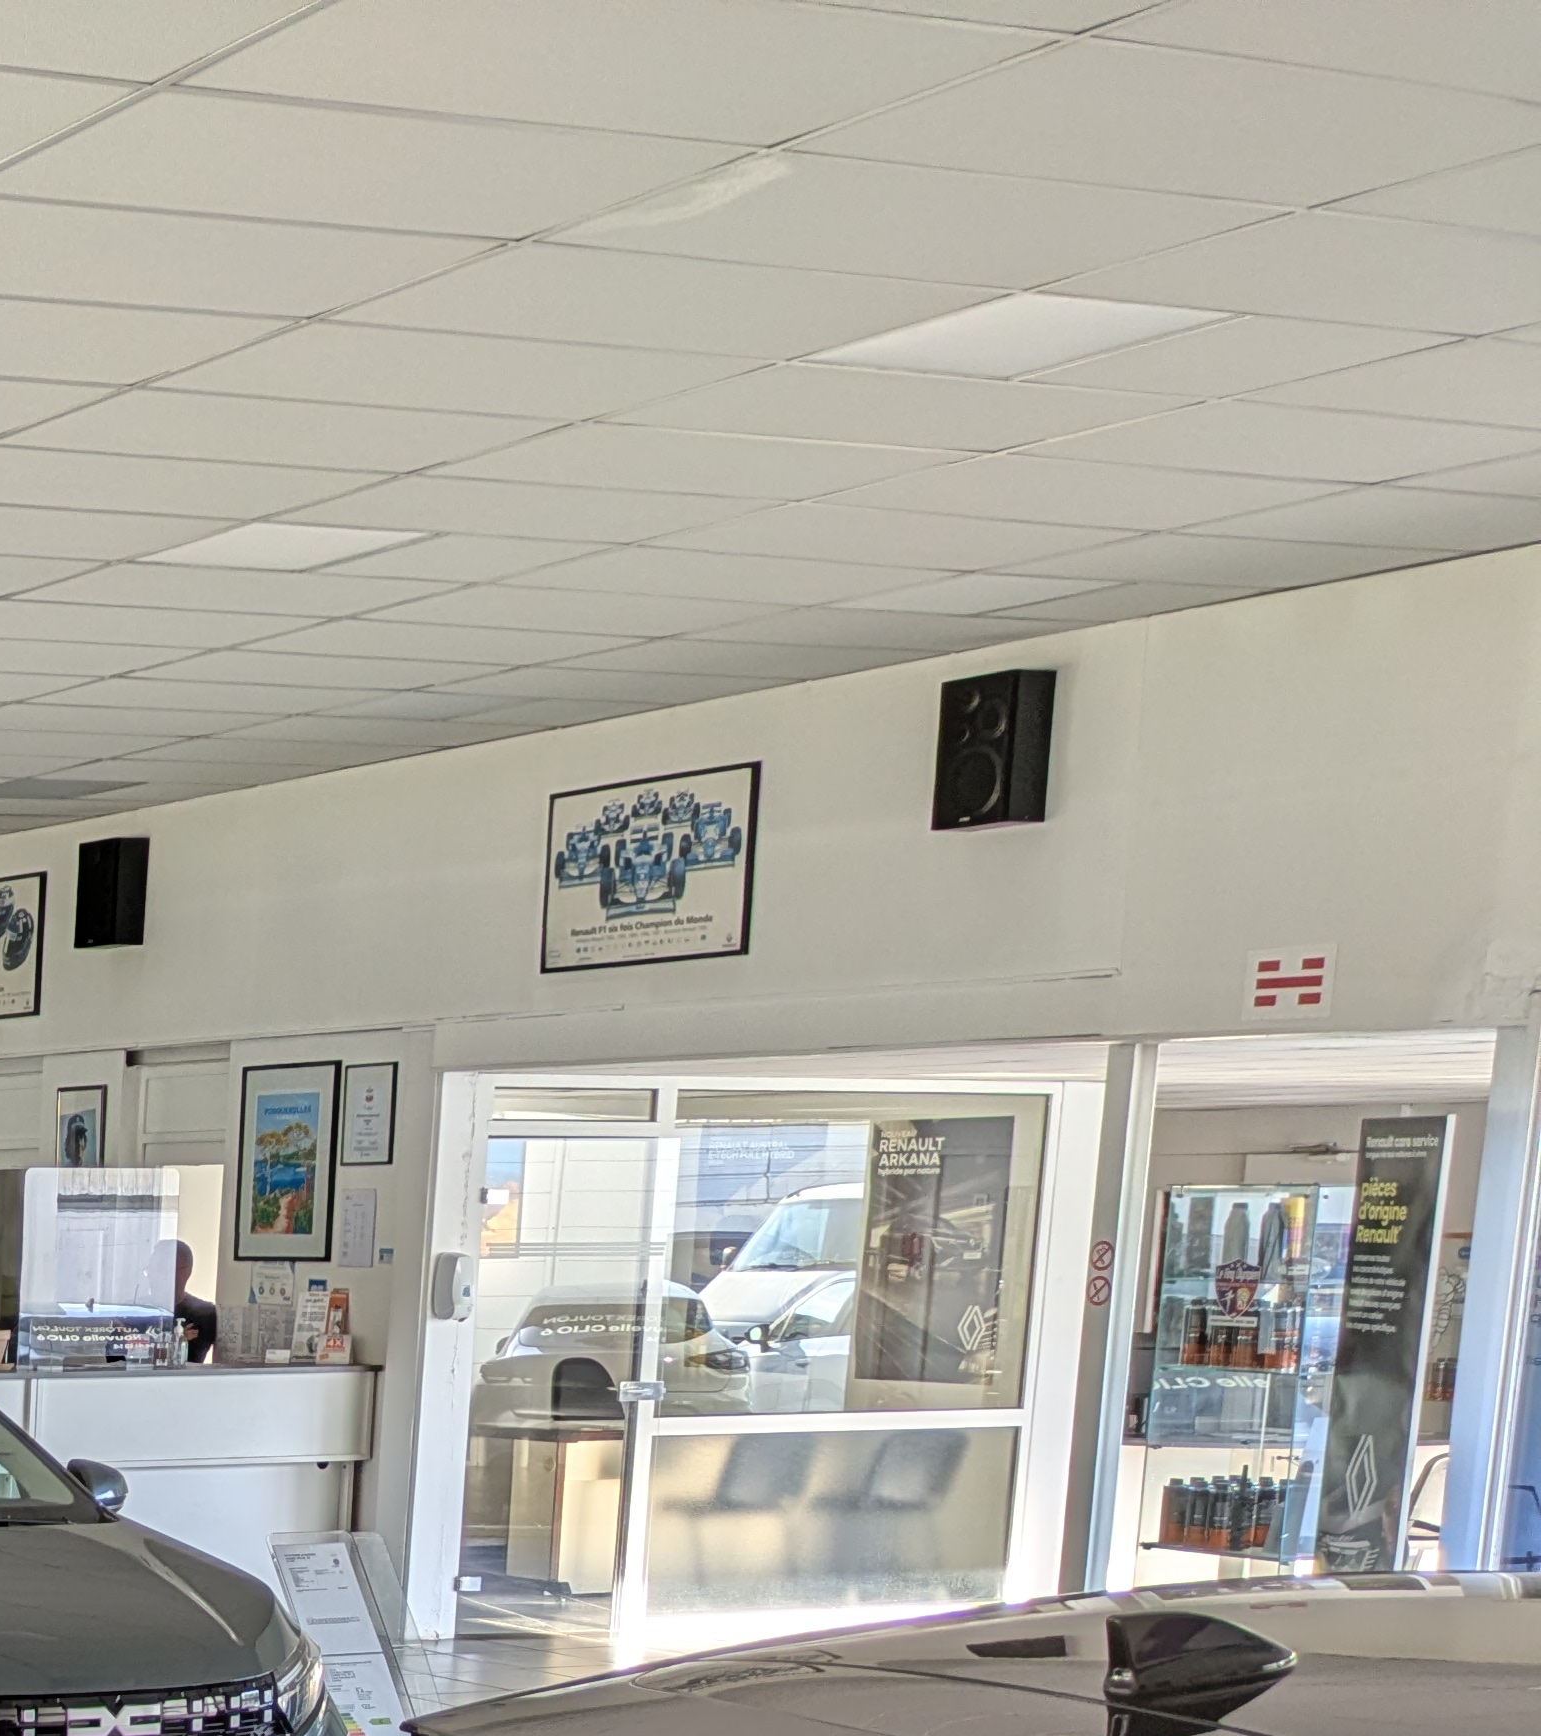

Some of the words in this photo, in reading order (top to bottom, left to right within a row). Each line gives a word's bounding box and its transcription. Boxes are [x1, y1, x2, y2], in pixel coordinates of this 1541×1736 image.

[634, 919, 673, 931] Champion
[879, 1137, 945, 1152] RENAULT
[878, 1152, 941, 1166] ARKANA
[1360, 1177, 1398, 1202] pièces
[1358, 1200, 1408, 1226] d'origine
